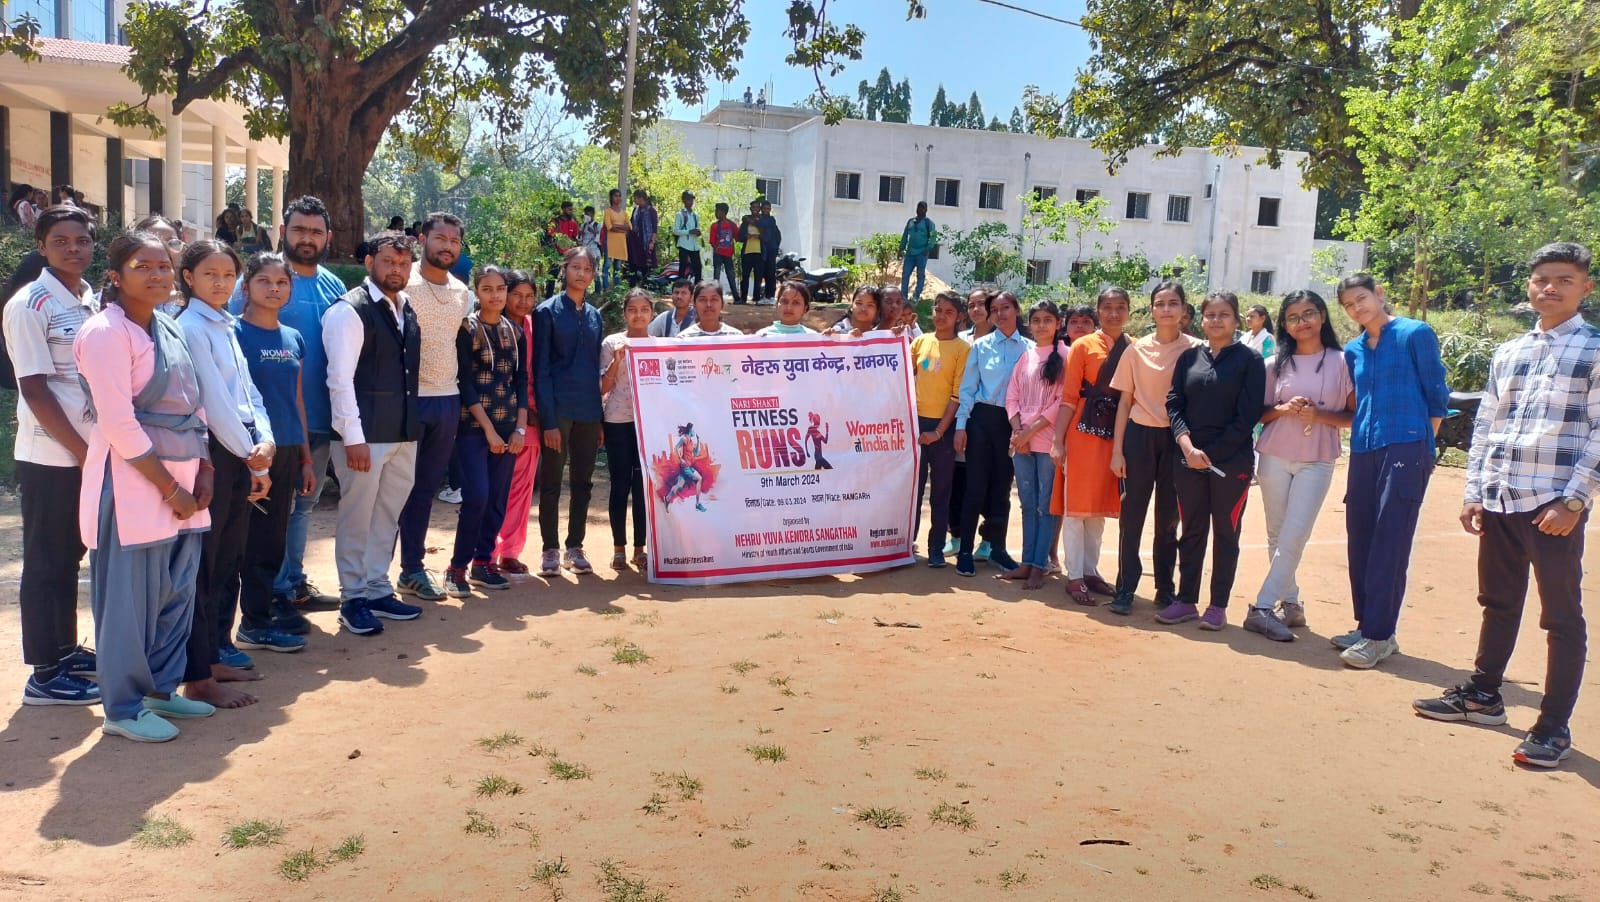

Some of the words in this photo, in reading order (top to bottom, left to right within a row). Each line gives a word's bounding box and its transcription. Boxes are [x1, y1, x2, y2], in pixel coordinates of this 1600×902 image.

[741, 355, 780, 376] नेहरू
[783, 358, 809, 381] युवा
[812, 352, 851, 374] केन्द्र,
[853, 353, 899, 372] रामगढ़
[732, 399, 750, 409] NARI
[752, 398, 779, 409] SHAKTI
[732, 408, 798, 427] FITNESS
[845, 420, 889, 437] Women
[891, 418, 905, 434] Fit
[735, 427, 806, 469] RUNS
[862, 435, 889, 452] India
[891, 435, 905, 451] hit
[760, 477, 774, 488] 9th
[776, 475, 800, 486] March
[802, 474, 820, 485] 2024
[734, 533, 761, 547] NEHRU
[763, 531, 784, 545] YUVA
[785, 529, 815, 544] KENDRA
[816, 526, 858, 541] SANGATHAN
